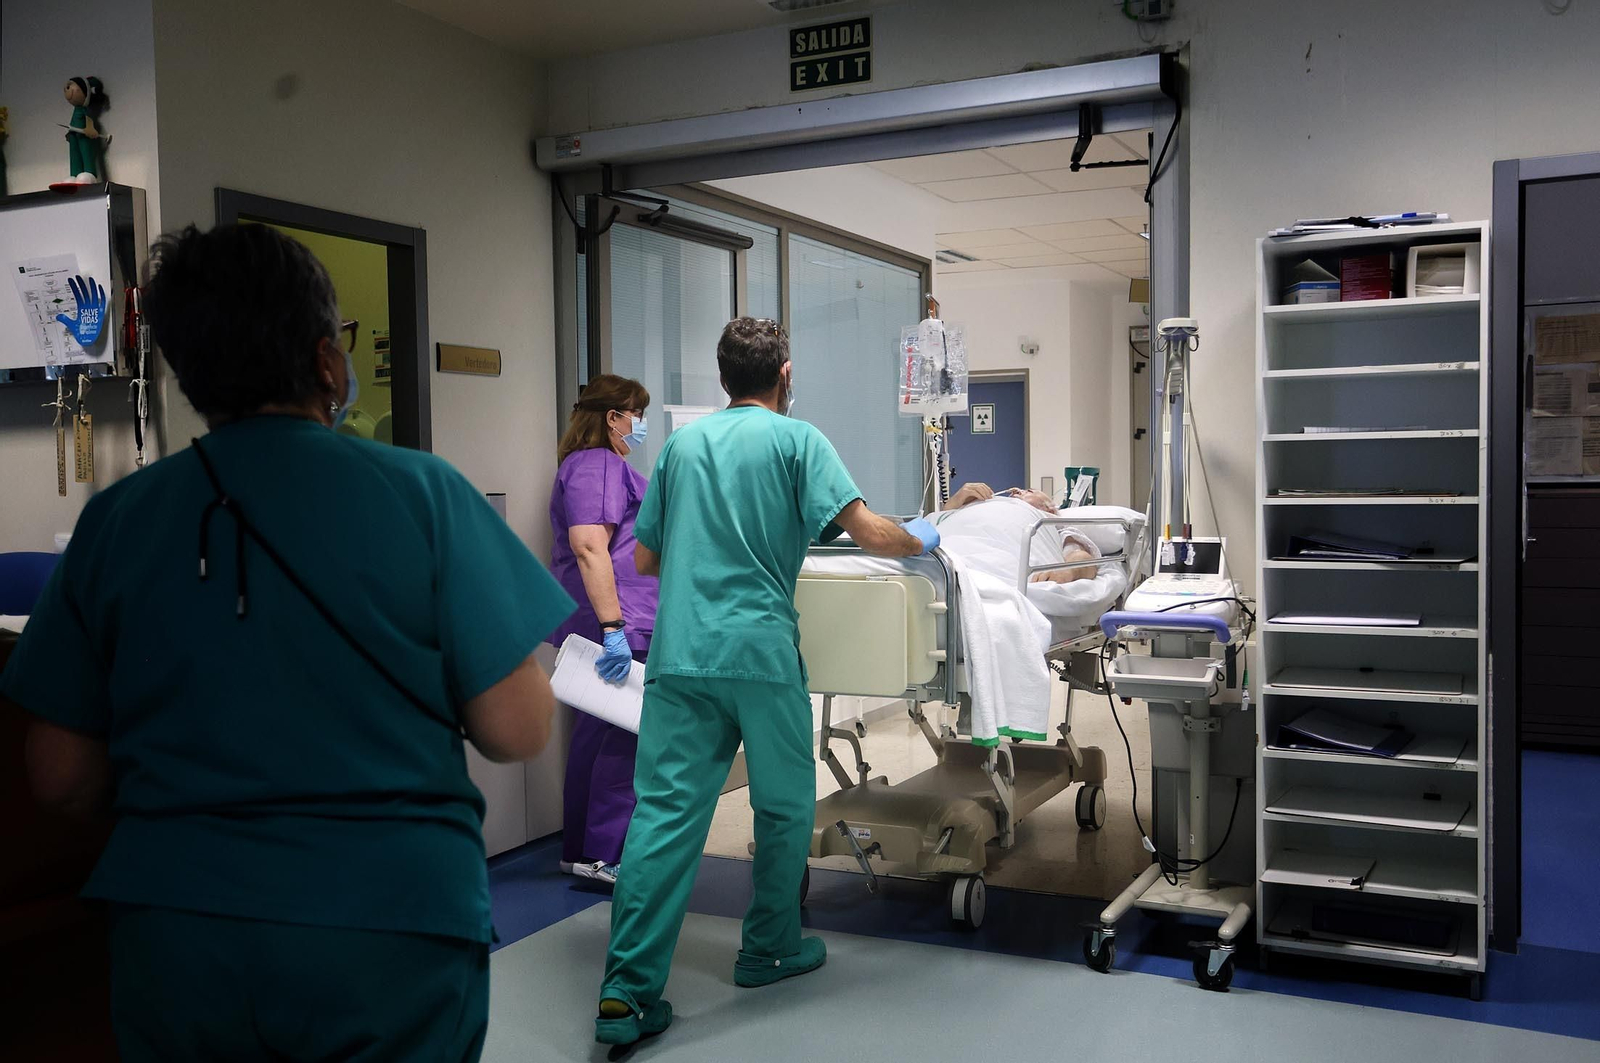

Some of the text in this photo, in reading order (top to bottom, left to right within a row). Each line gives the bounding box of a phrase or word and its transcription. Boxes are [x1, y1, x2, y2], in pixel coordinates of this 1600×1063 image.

[795, 23, 864, 53] SALIDA
[796, 56, 867, 86] EXIT
[80, 308, 98, 317] SALVE
[80, 316, 98, 324] VIDAS
